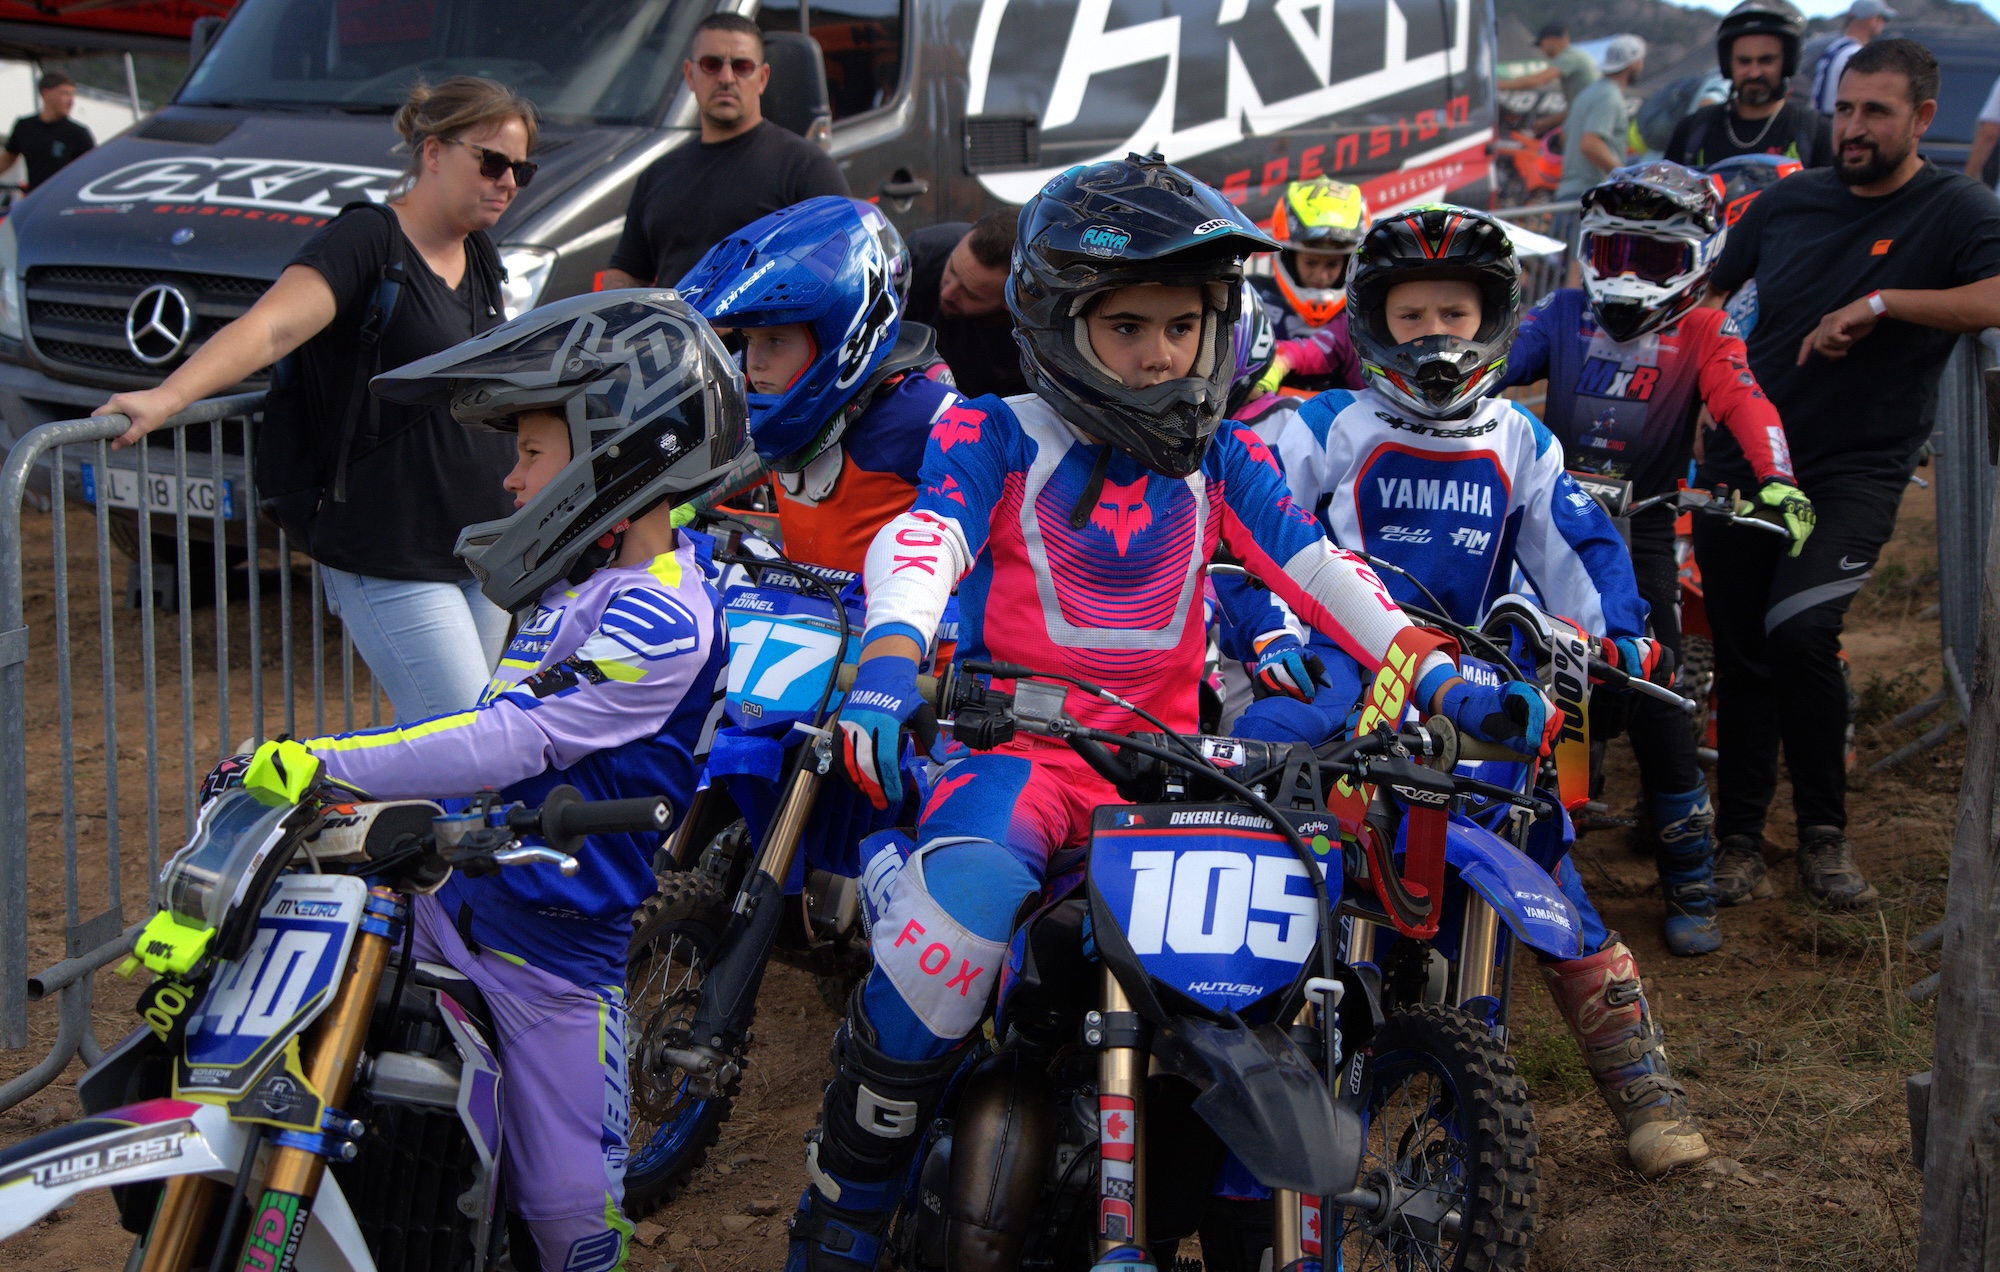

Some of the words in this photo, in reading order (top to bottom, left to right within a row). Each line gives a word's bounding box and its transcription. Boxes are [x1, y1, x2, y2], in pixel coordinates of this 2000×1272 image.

[154, 204, 330, 228] SUSPENSI
[715, 260, 776, 316] alpinestars
[1375, 411, 1498, 438] alpinestars
[538, 482, 586, 530] ATR-3
[553, 506, 608, 550] ADVANCED
[613, 475, 652, 505] IMPACT
[658, 439, 702, 471] DEFENSE
[1377, 477, 1492, 517] YAMAHA
[1379, 525, 1430, 536] BLU
[1381, 533, 1433, 544] CRU
[1450, 527, 1491, 550] FIM
[798, 564, 857, 582] NTHAL
[727, 598, 775, 612] JOINEL
[740, 592, 761, 600] NOE
[726, 620, 842, 701] 17
[1463, 665, 1499, 687] MAHA
[848, 690, 902, 711] YAMAHA
[1555, 638, 1585, 744] 100%
[1213, 744, 1235, 759] 13
[1392, 784, 1450, 805] ARC
[1170, 812, 1223, 825] DEKERLE
[1224, 812, 1274, 829] Léandro
[1298, 821, 1329, 834] enduro
[1128, 851, 1328, 964] 105
[1523, 906, 1573, 930] YAMALUBE
[145, 940, 178, 960] 100%
[894, 918, 984, 997] FOX
[186, 928, 332, 1037] 40
[29, 1153, 102, 1185] TWO
[107, 1132, 186, 1164] FAST
